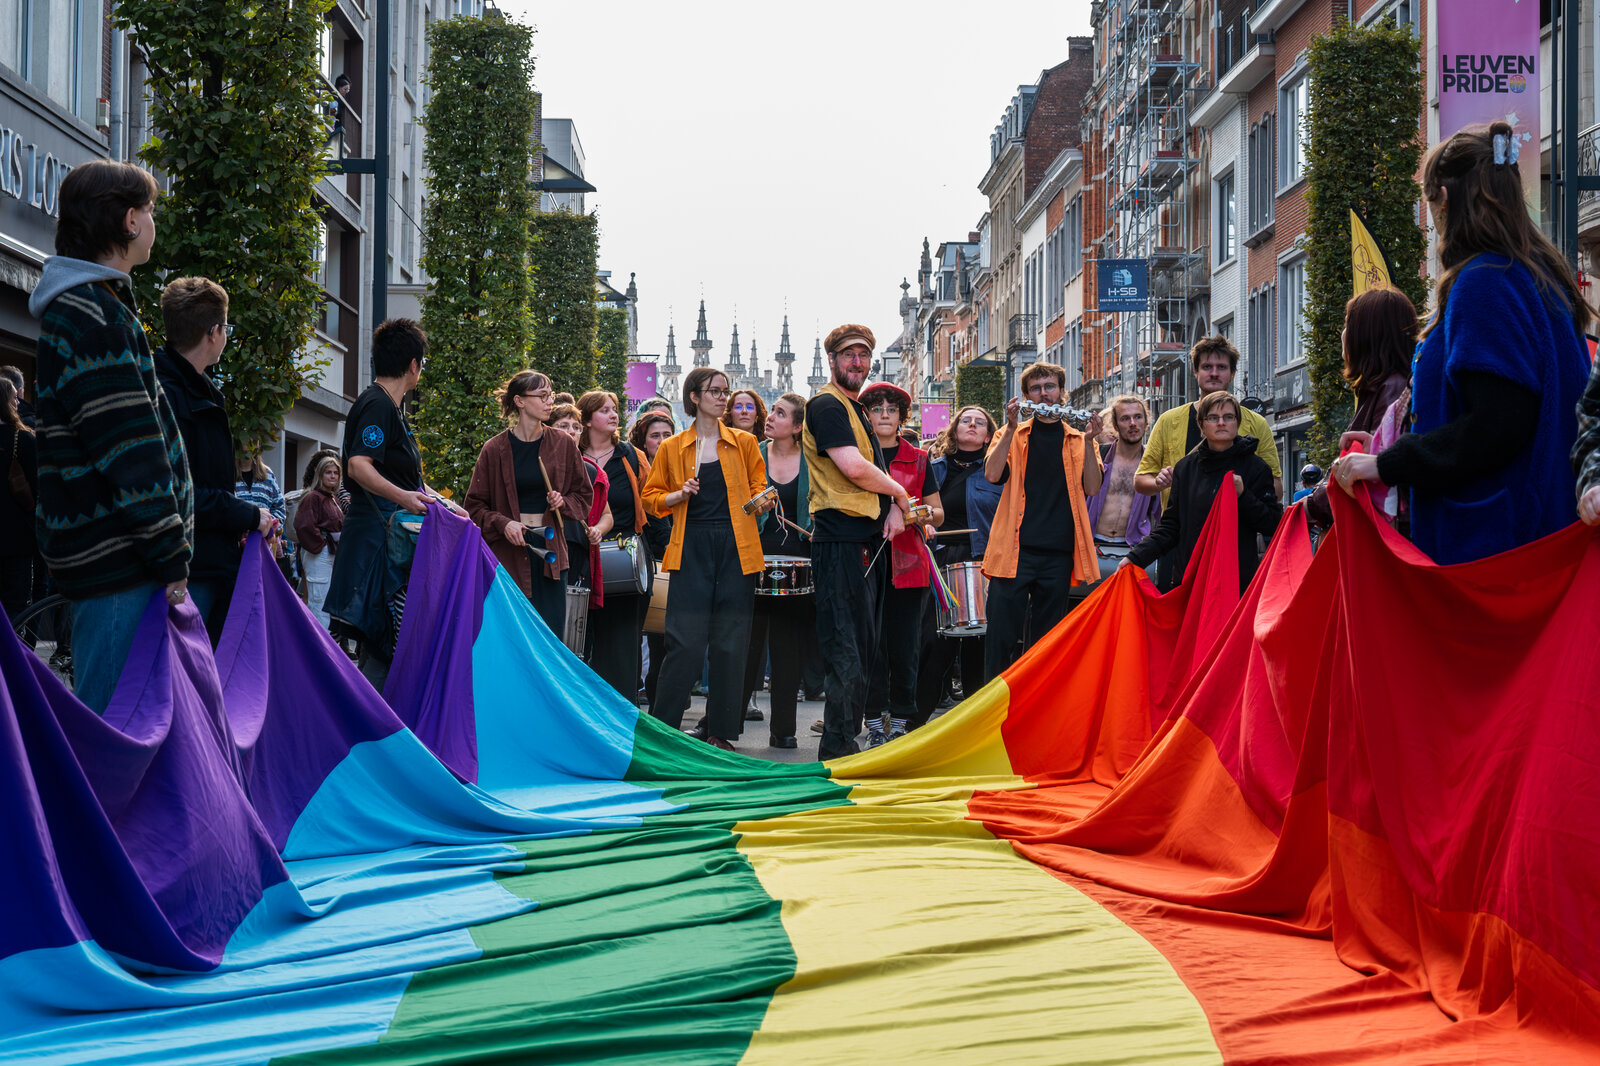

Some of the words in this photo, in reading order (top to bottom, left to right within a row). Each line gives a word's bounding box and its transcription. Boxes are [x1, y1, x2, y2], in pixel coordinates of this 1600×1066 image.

[1442, 54, 1535, 74] LEUVEN
[1442, 74, 1509, 93] PRIDE
[1108, 287, 1138, 296] H-SB
